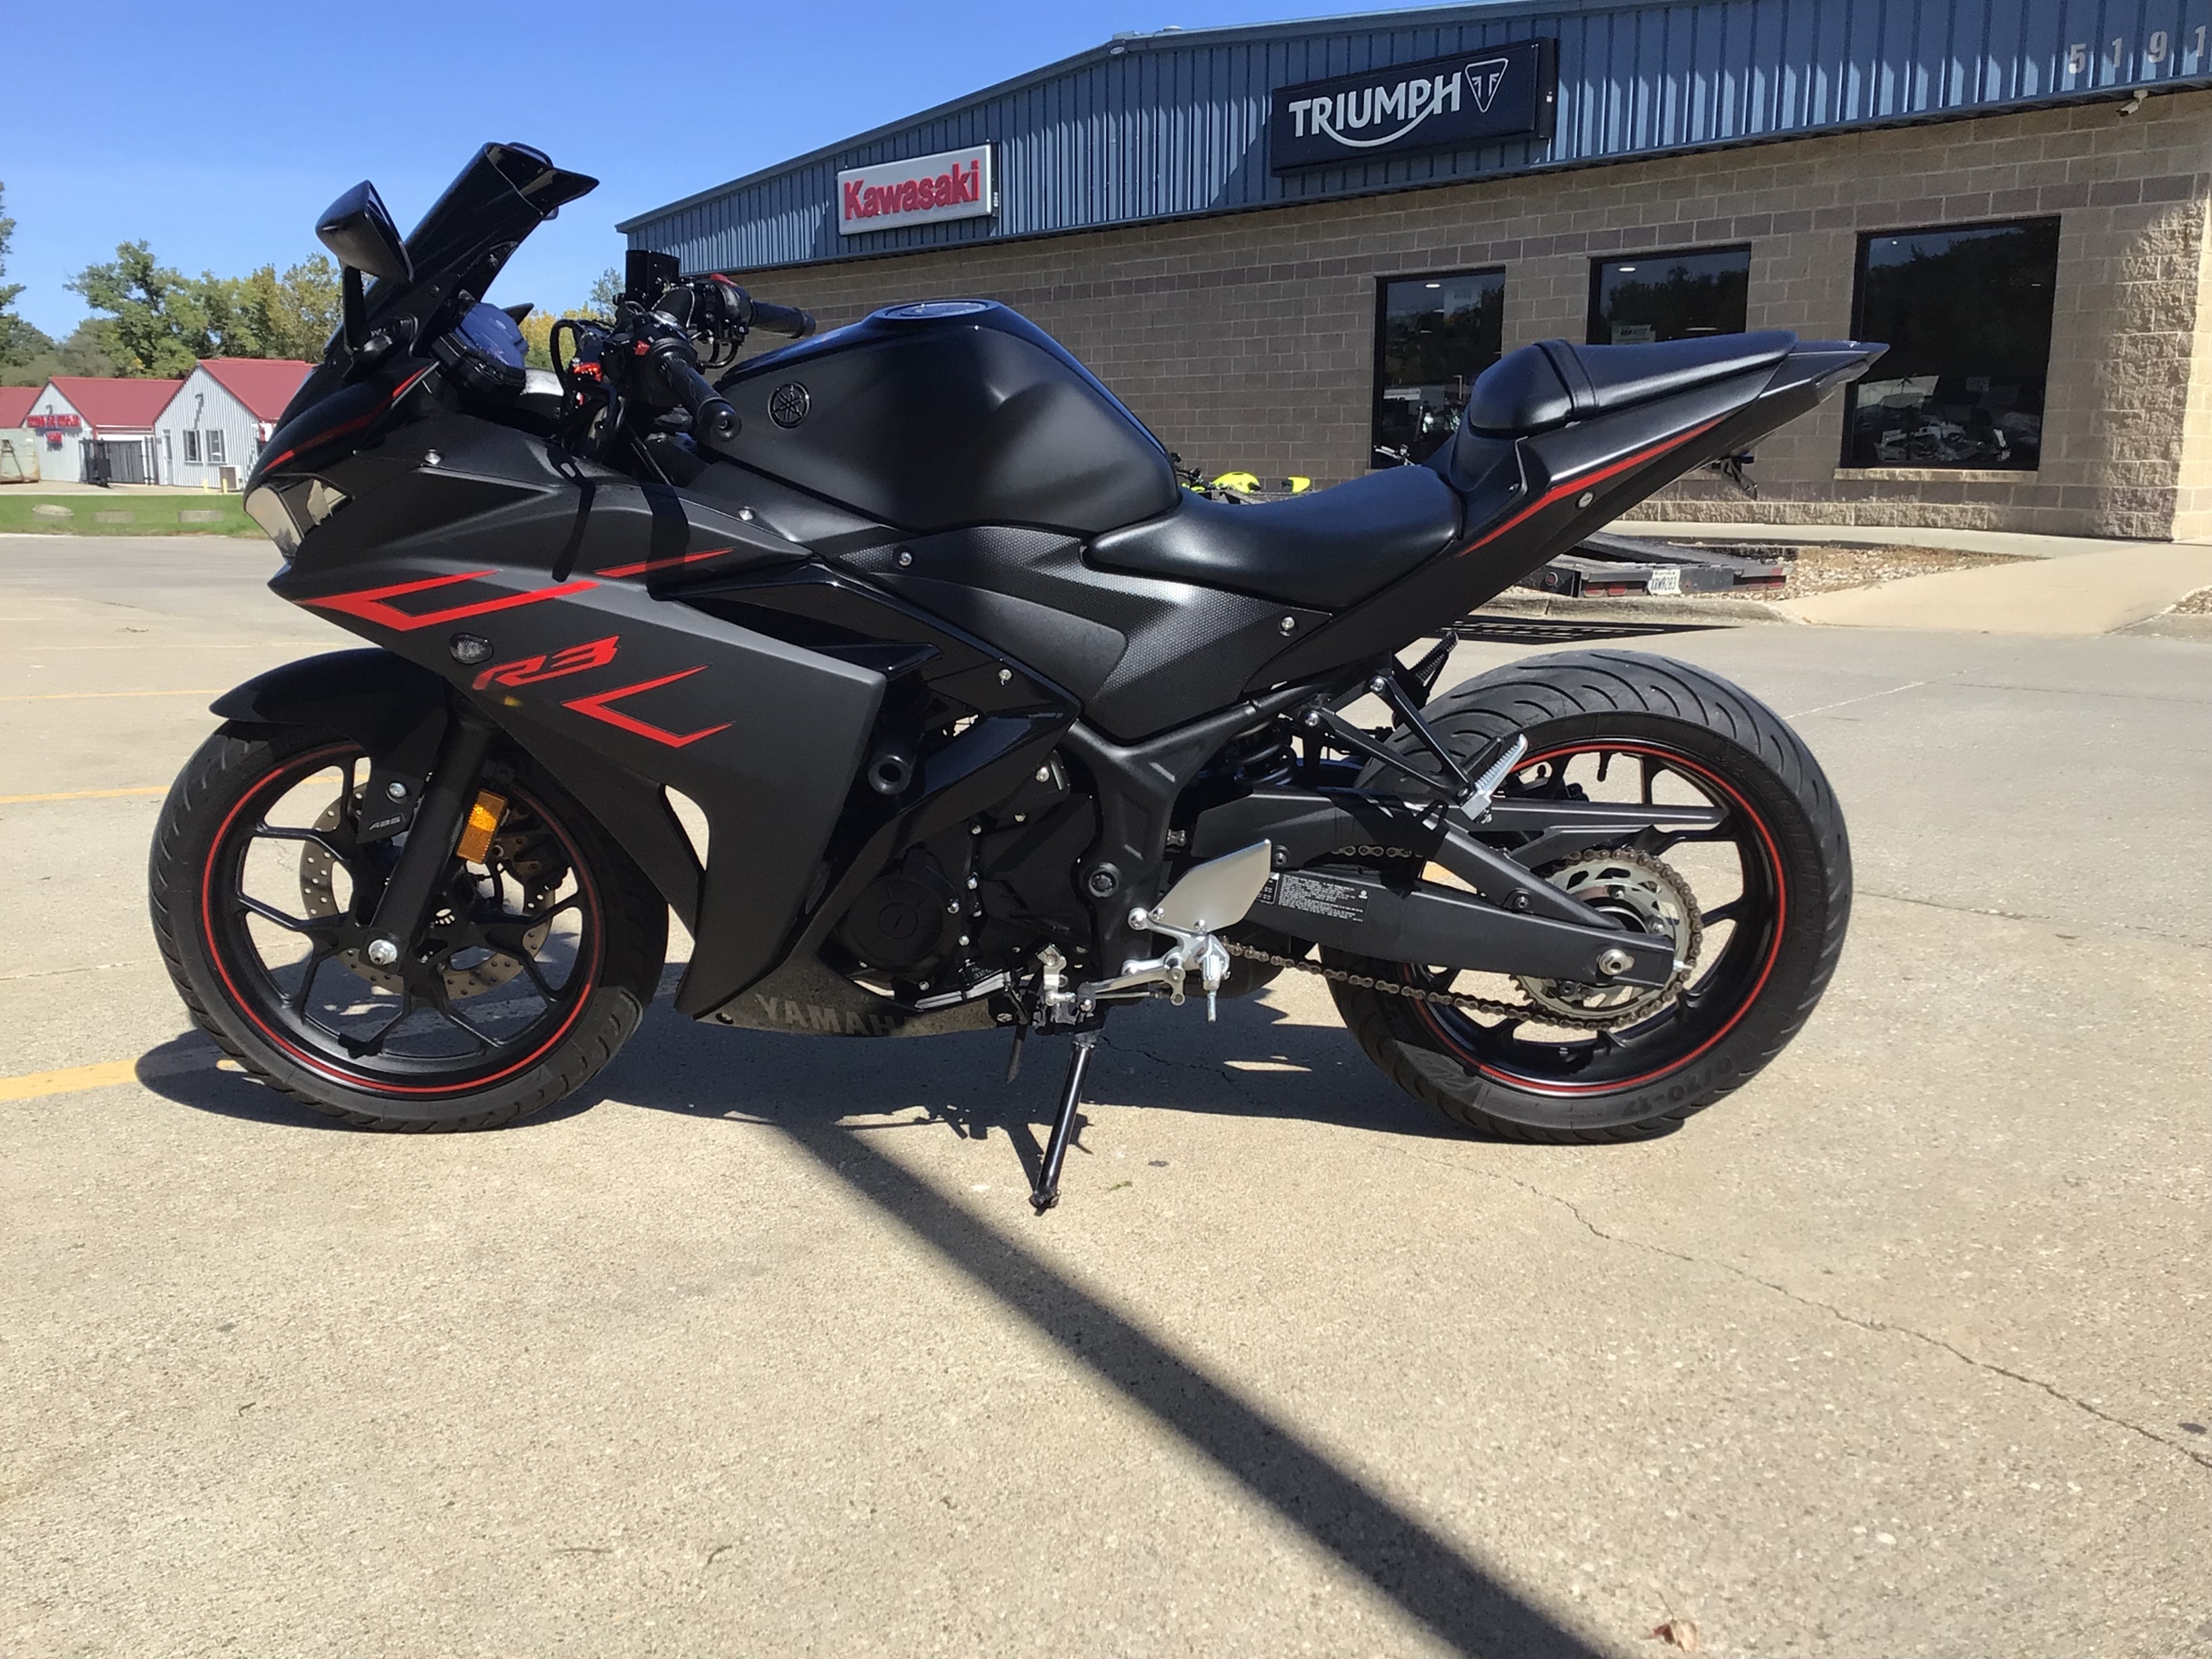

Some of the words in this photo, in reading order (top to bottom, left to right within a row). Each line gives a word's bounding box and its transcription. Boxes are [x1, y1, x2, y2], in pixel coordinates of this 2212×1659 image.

[1288, 71, 1462, 148] TRIUMPH
[844, 159, 980, 220] Kawasaki
[369, 816, 401, 831] ABS
[755, 993, 916, 1036] YAMAH
